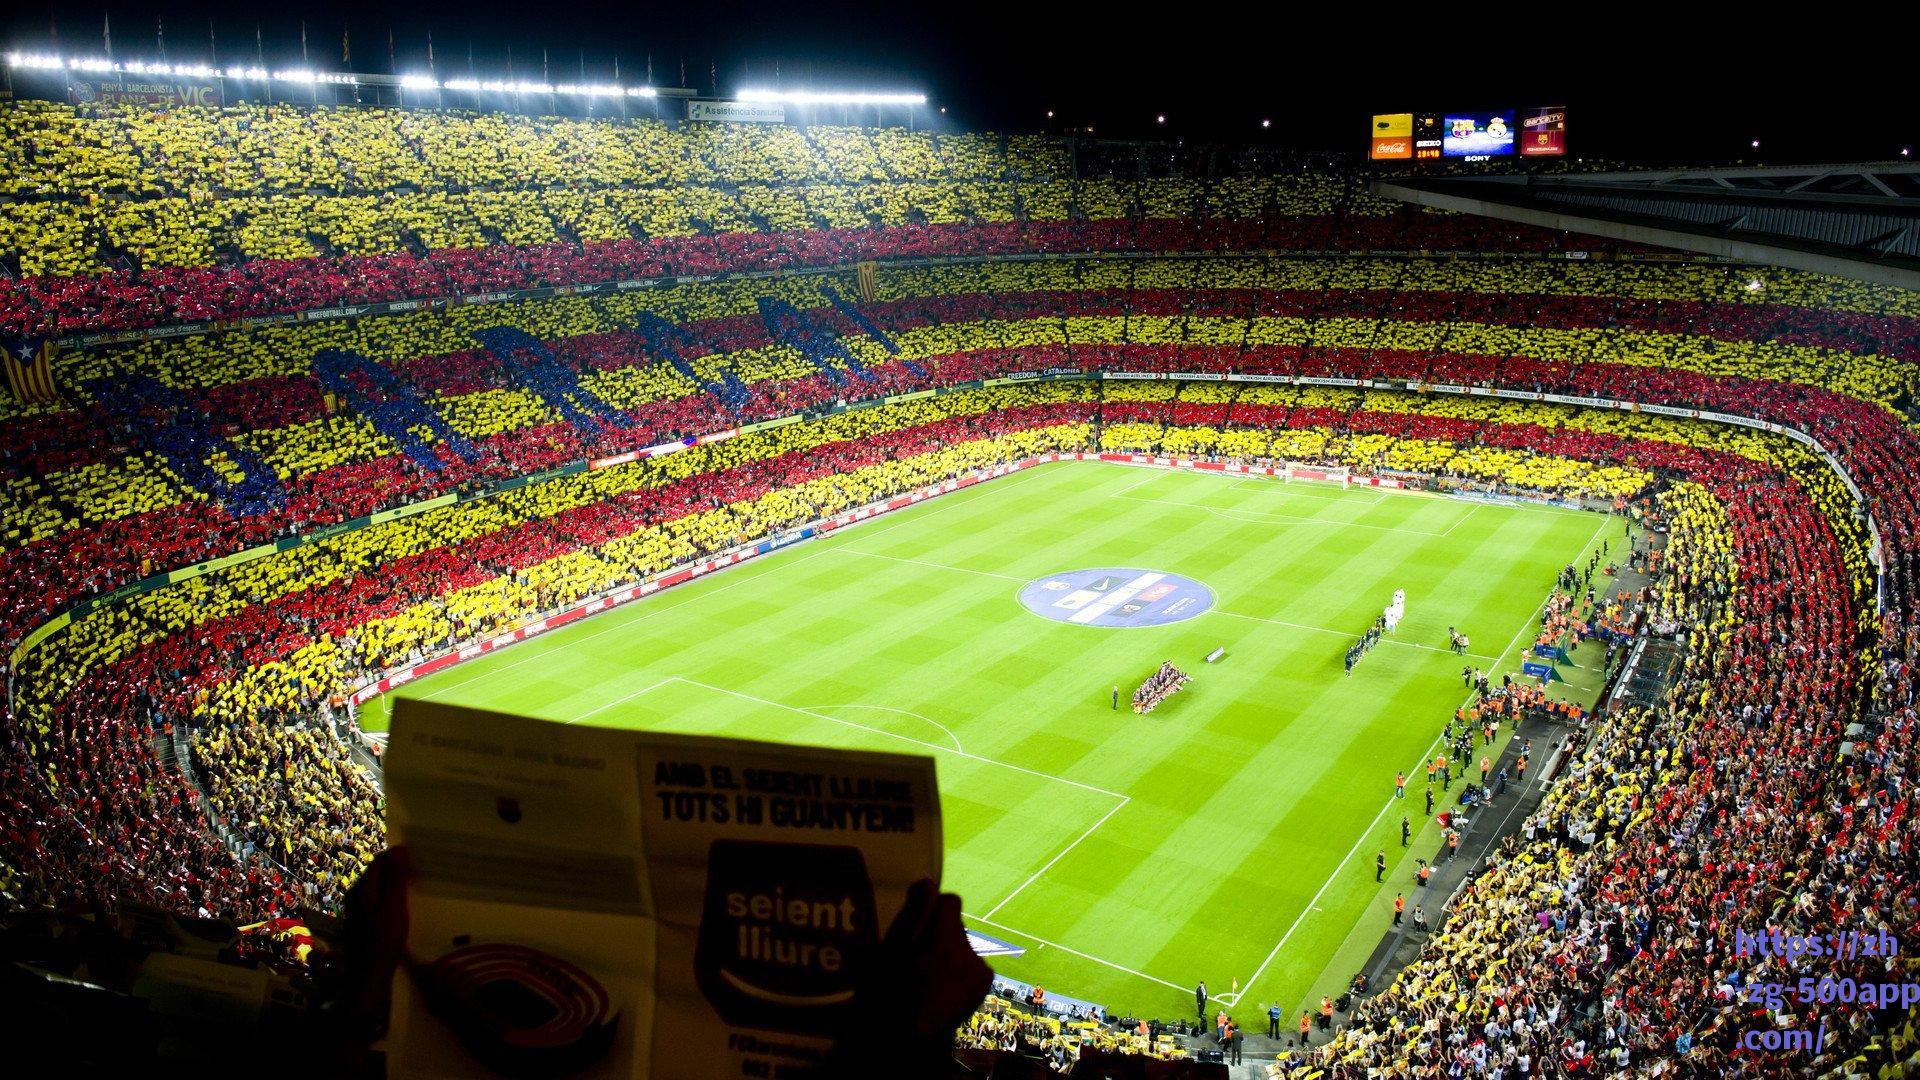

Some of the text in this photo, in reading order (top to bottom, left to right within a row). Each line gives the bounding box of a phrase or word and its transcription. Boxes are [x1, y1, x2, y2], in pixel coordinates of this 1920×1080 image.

[102, 83, 174, 94] PENYA BARCELONISTA
[177, 86, 213, 106] VIC
[308, 308, 358, 320] NIKEFOOTBALL.COM
[1007, 368, 1081, 380] FREEDOM CATALONIA
[1558, 396, 1584, 404] TURKISH
[1662, 407, 1689, 415] AIRLINES
[1714, 413, 1767, 428] TURKISH AIRLINES
[655, 763, 706, 787] AMB
[711, 765, 738, 790] EL
[744, 768, 822, 797] SEIENT
[658, 792, 729, 823] TOTS
[736, 793, 762, 825] HI
[726, 883, 857, 934] seient
[739, 923, 844, 974] lliure
